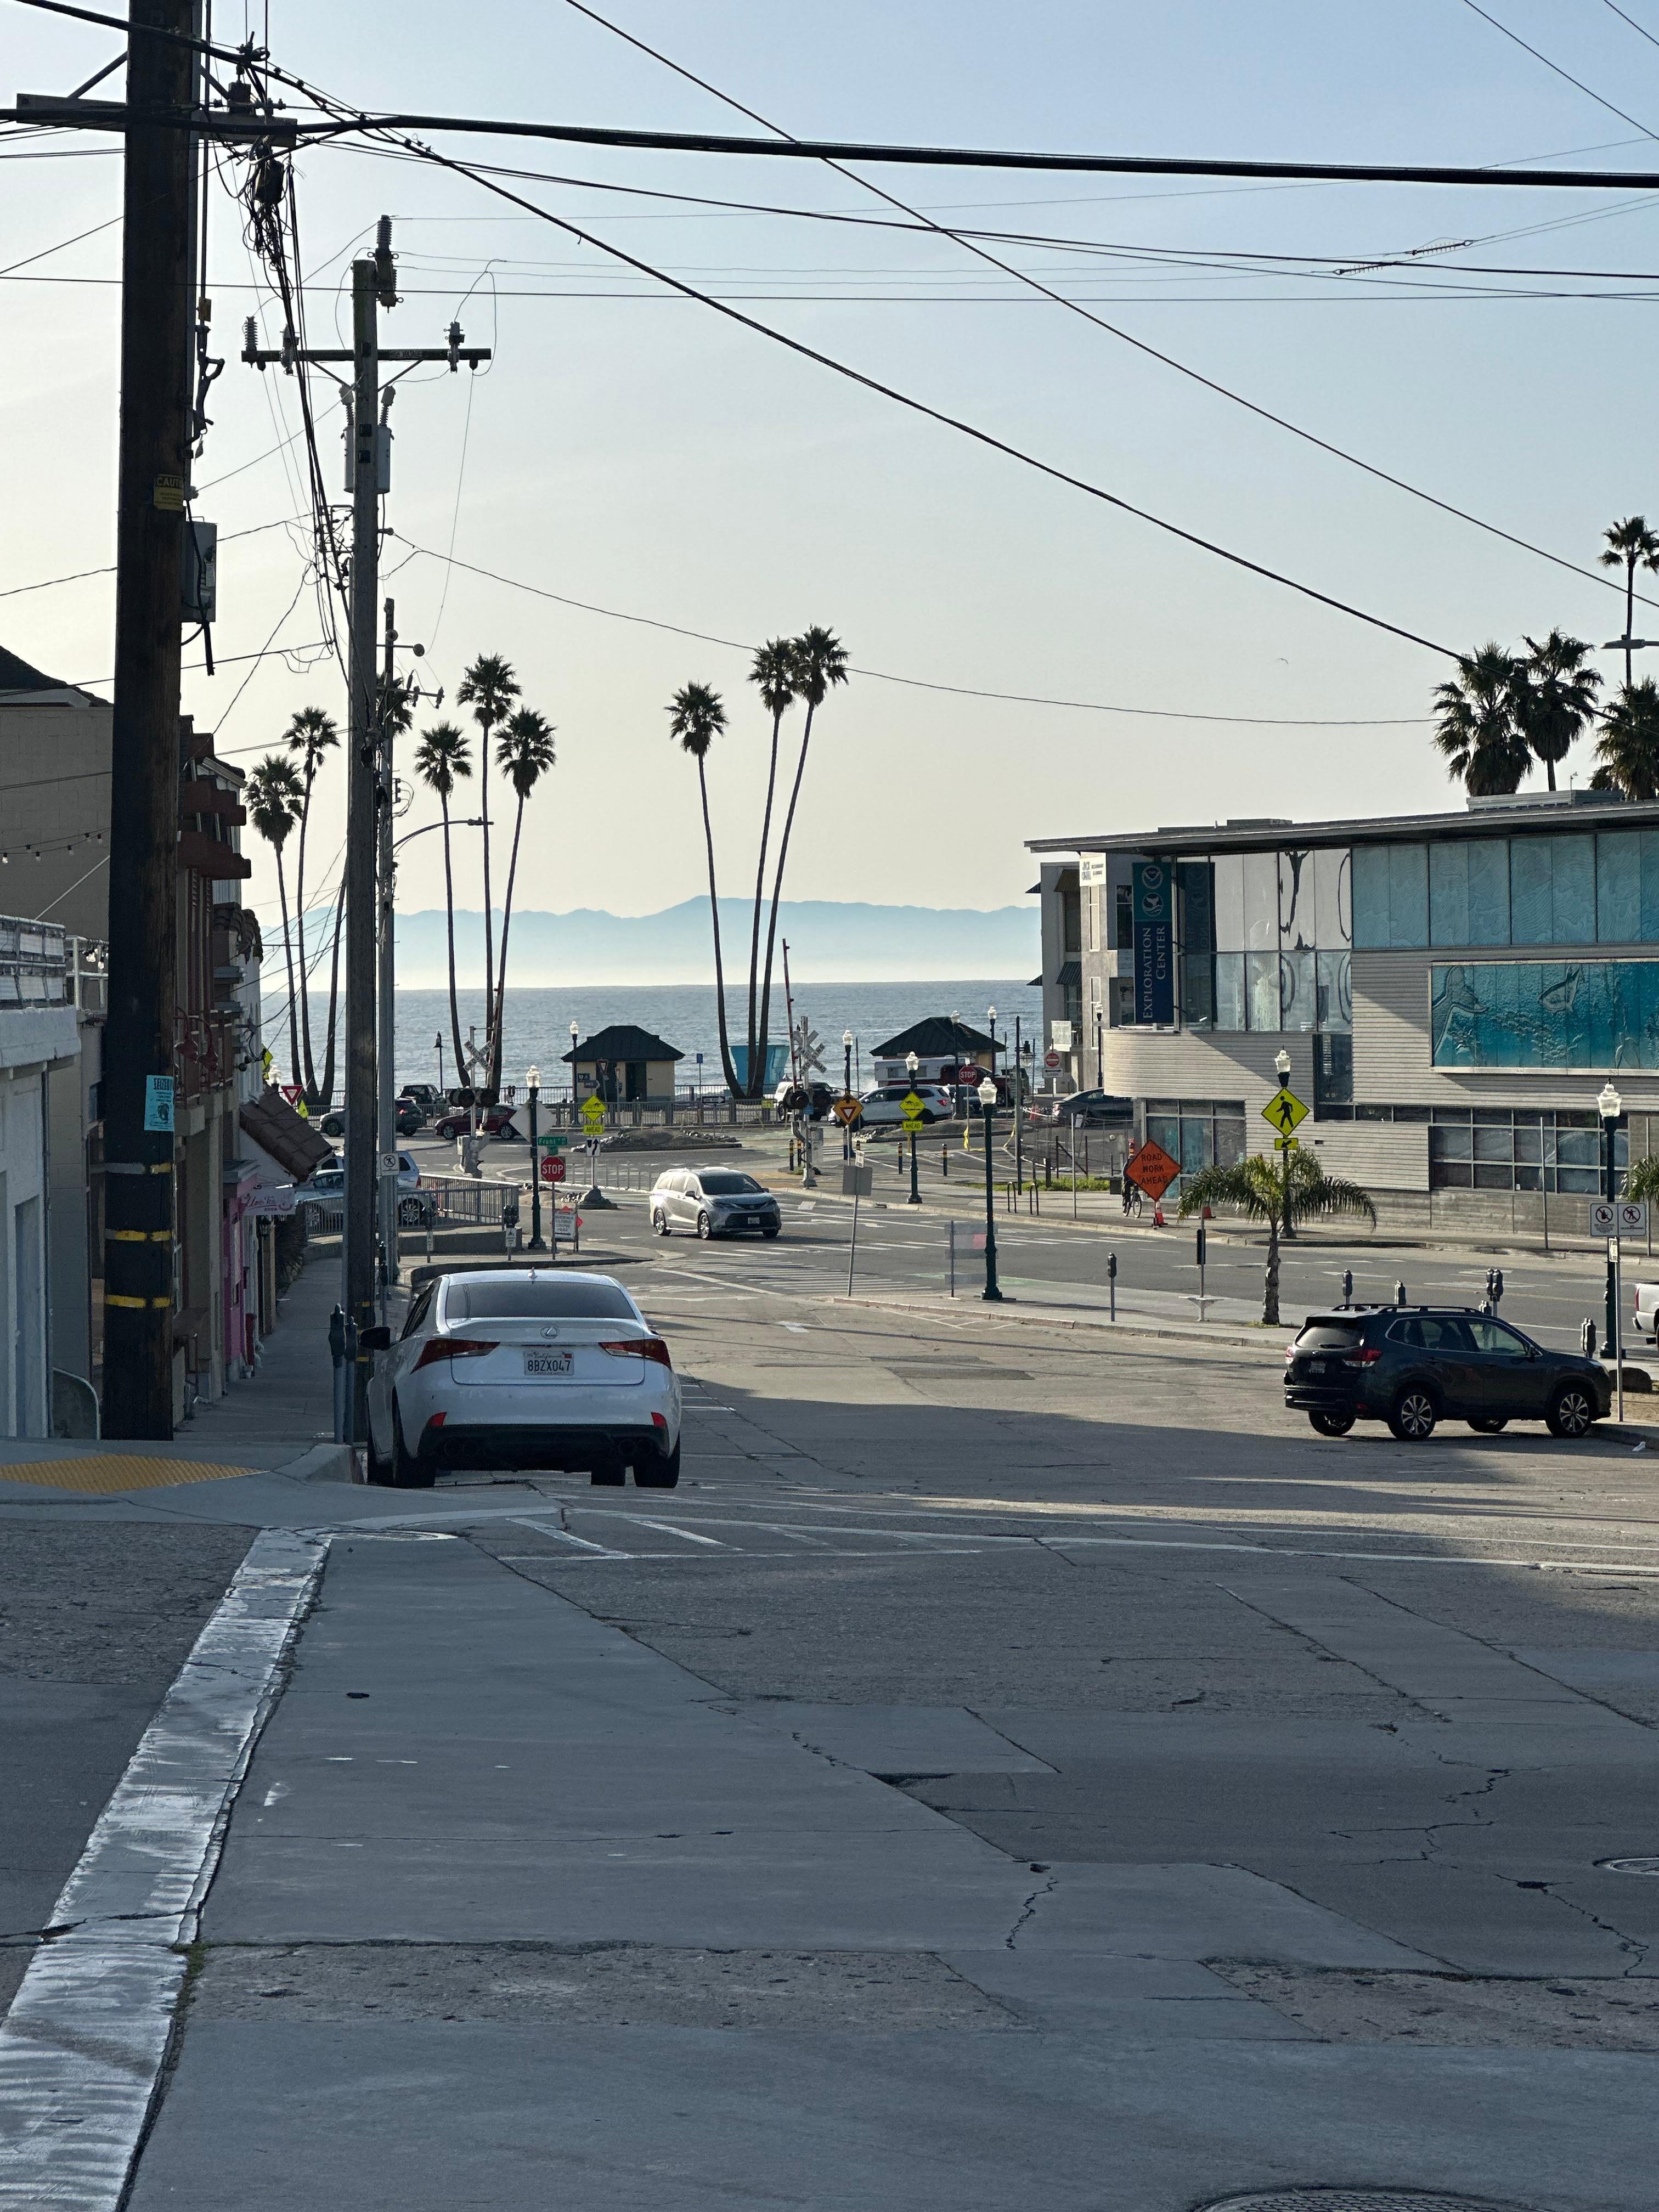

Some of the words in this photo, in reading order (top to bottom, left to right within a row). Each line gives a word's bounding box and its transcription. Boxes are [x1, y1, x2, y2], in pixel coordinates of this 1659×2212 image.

[1156, 926, 1166, 980] CENTER
[1143, 927, 1152, 1019] EXPLORATION
[542, 1164, 563, 1174] STOP
[1142, 1165, 1164, 1173] WORK
[1141, 1176, 1167, 1184] AHEAD
[528, 1360, 571, 1372] 8BZX047
